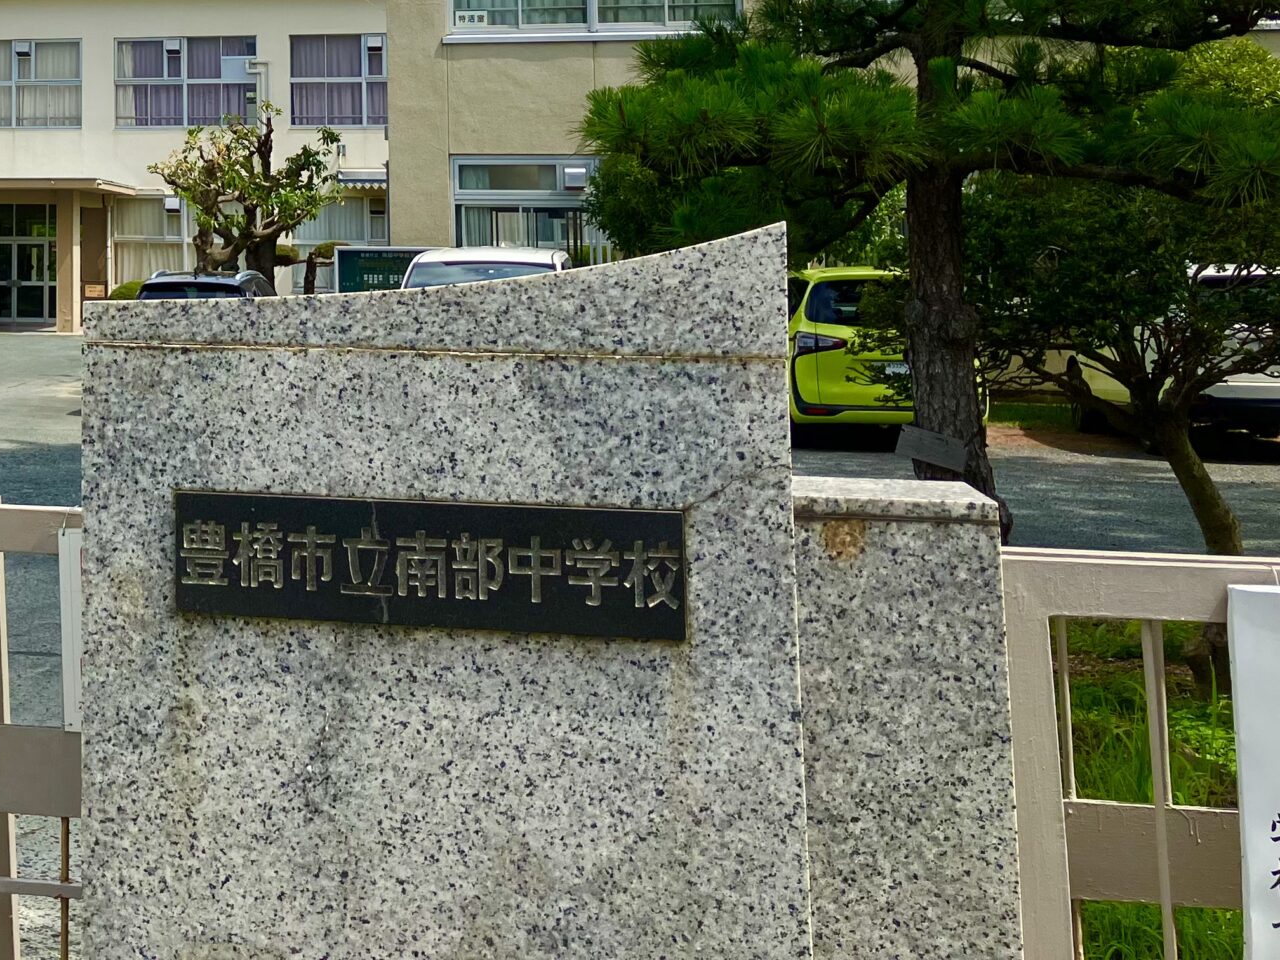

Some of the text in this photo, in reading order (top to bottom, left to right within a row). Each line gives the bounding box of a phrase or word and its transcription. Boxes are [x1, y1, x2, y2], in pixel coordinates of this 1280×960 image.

[179, 519, 681, 611] 豊橋市立南部中学校
